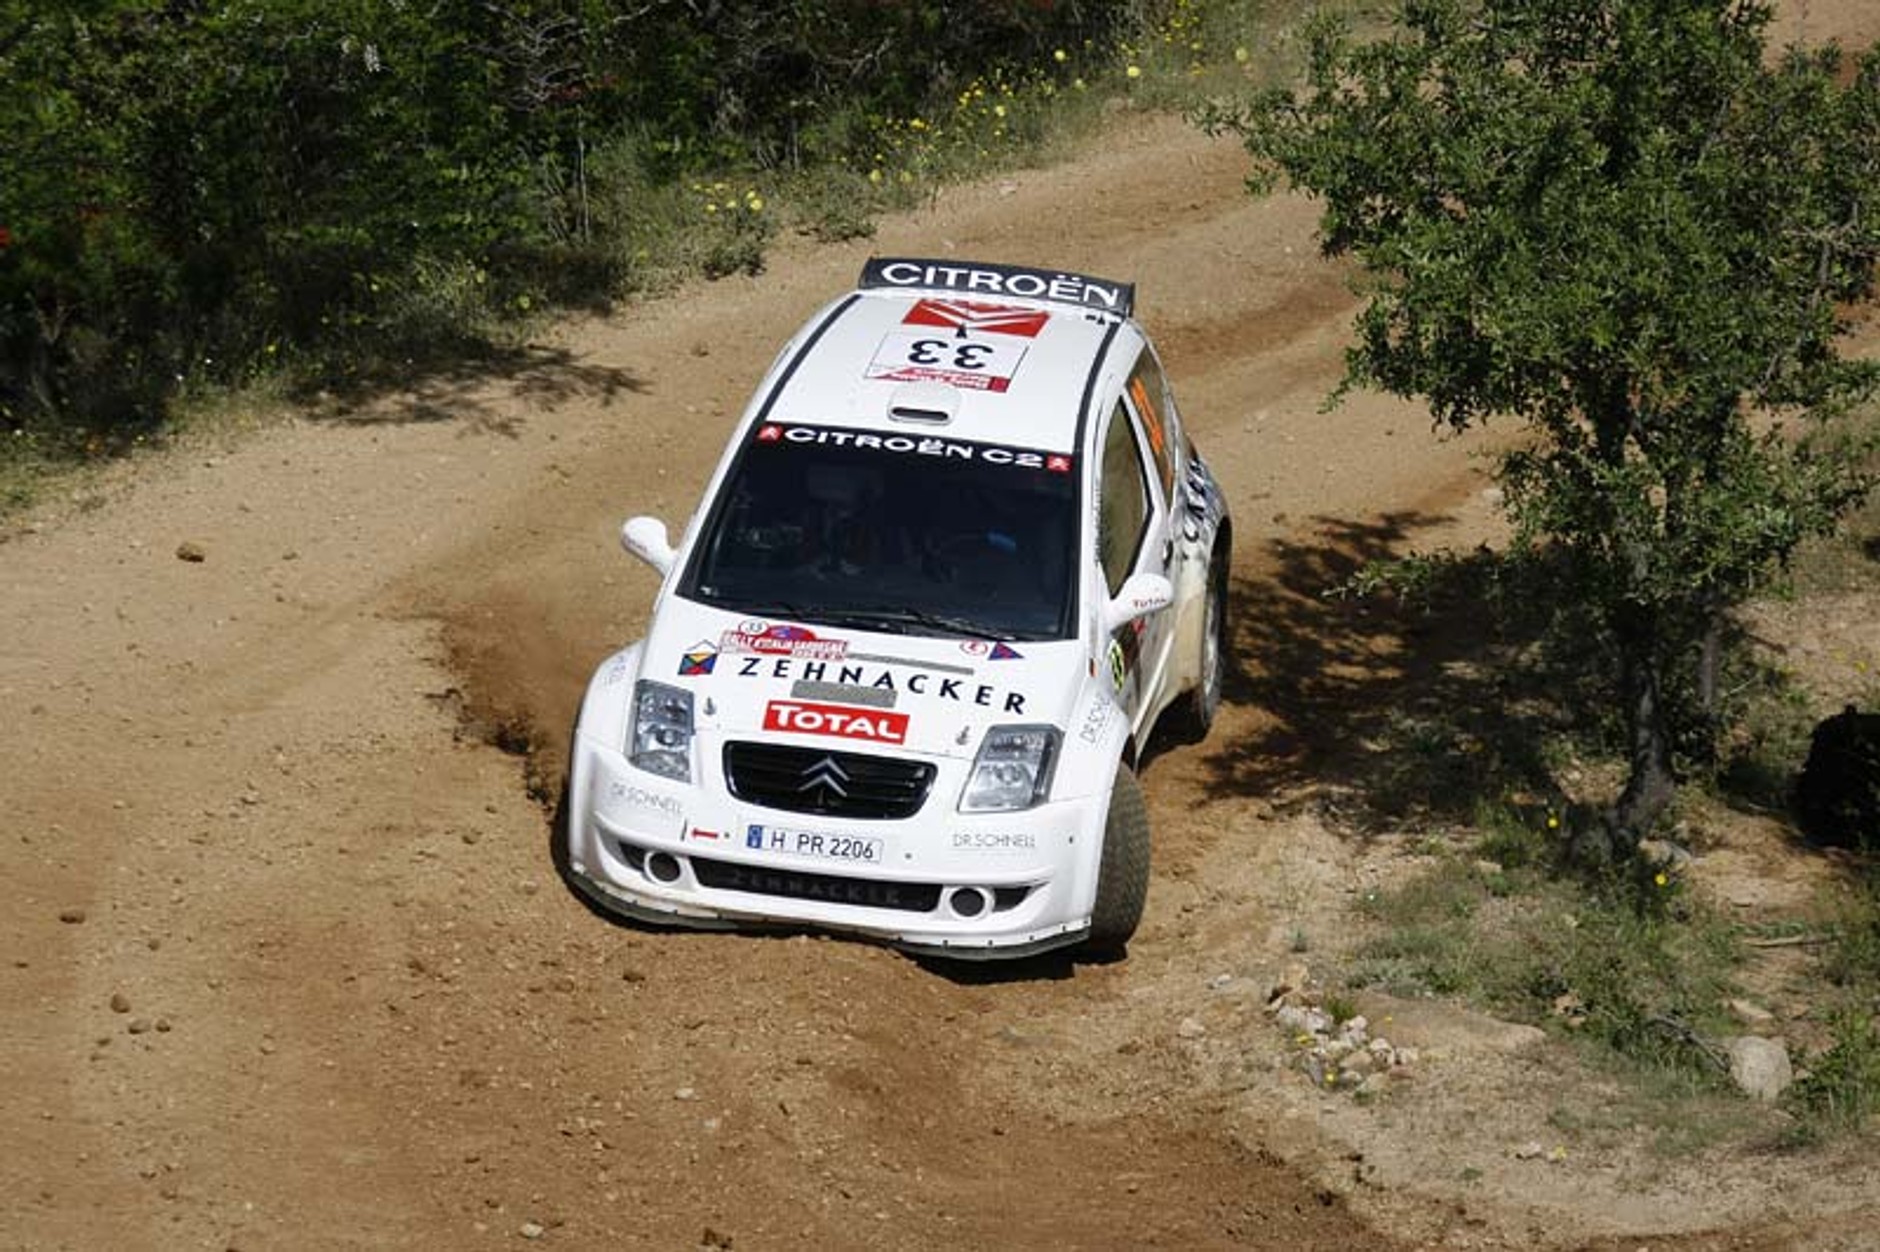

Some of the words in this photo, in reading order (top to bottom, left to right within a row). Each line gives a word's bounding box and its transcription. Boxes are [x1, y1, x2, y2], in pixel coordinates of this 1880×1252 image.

[881, 262, 1118, 306] CITROËN
[907, 339, 994, 369] 33
[784, 428, 973, 460] CITROËN
[982, 450, 1044, 468] C2
[738, 657, 1026, 715] ZEHNACKER
[770, 703, 904, 740] TOTAL
[771, 830, 786, 851] H
[797, 833, 824, 854] PR
[829, 838, 874, 860] 2206
